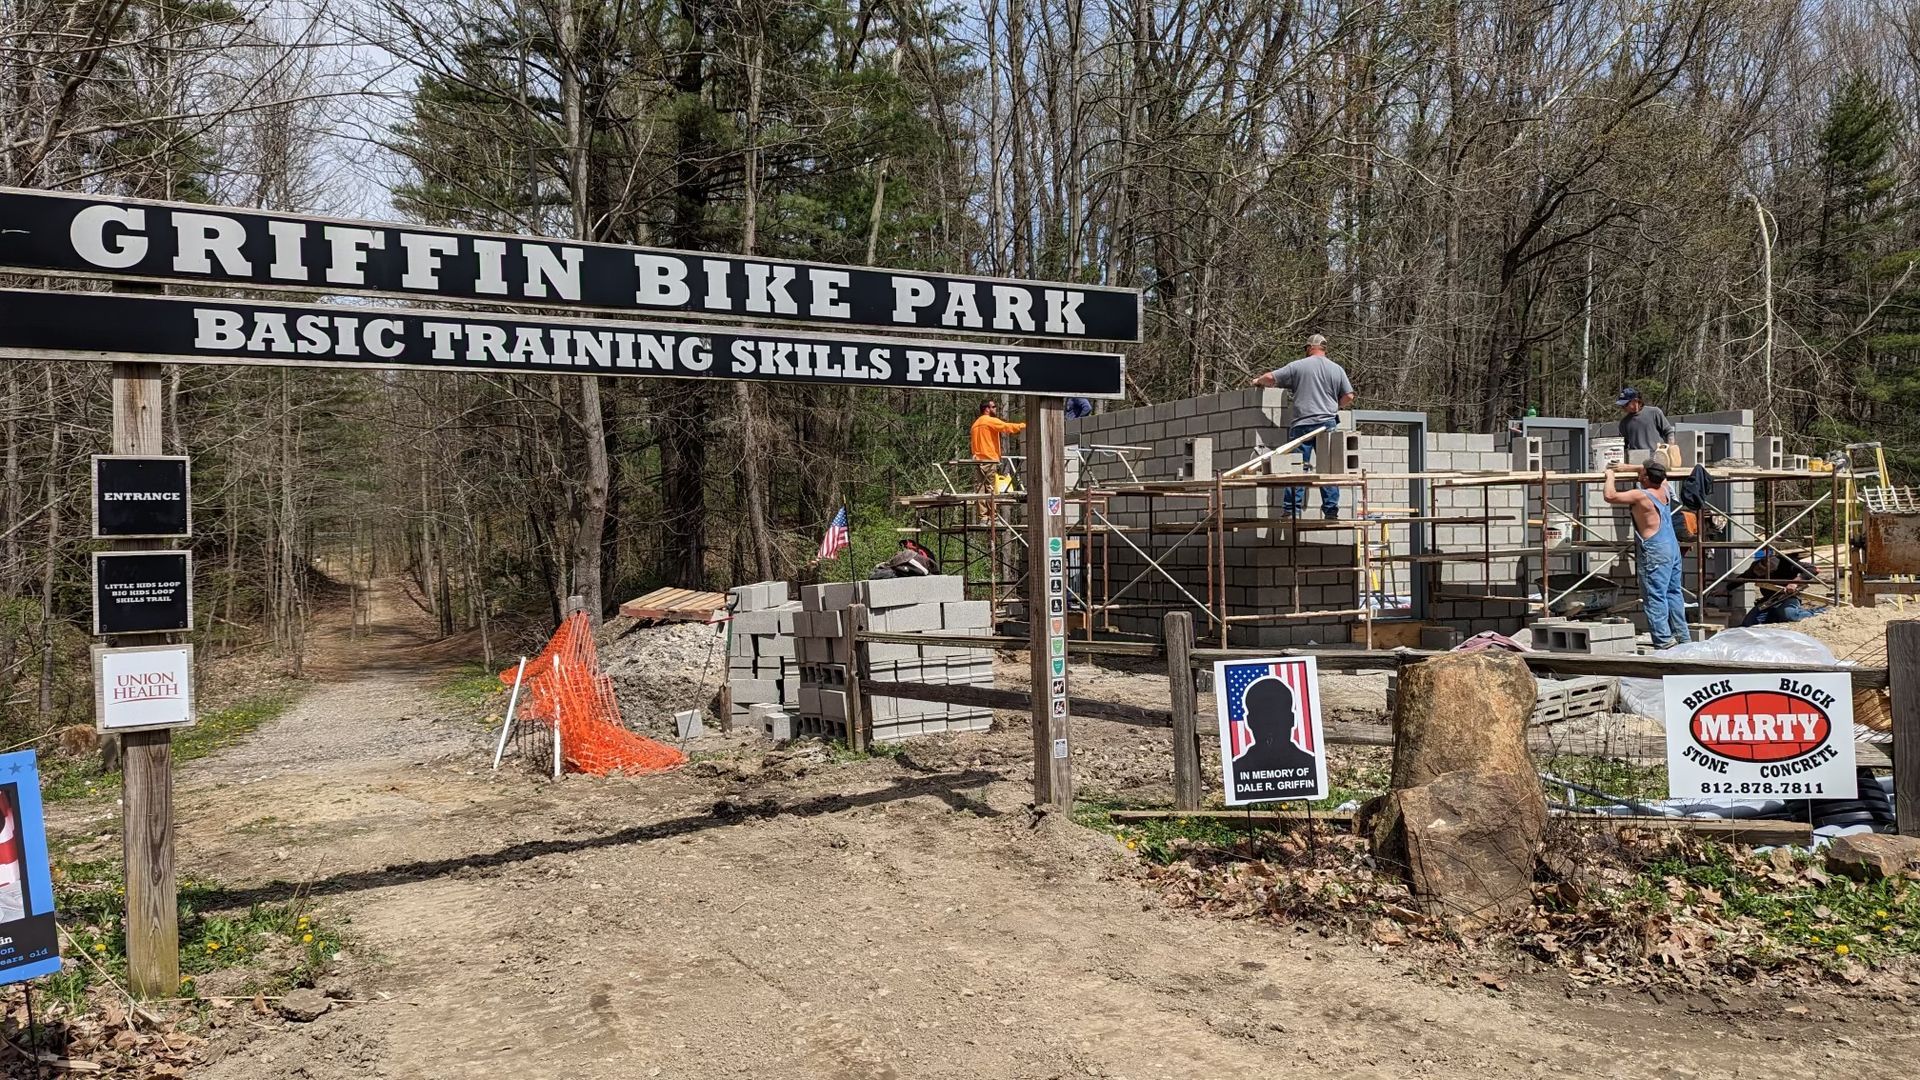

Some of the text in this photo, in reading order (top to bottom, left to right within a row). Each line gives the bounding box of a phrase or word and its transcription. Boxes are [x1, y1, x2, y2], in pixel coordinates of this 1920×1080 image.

[70, 204, 1086, 335] GRIFFIN BIKE PARK
[193, 308, 1022, 386] BASIC TRAINING SKILLS PARK
[104, 492, 180, 501] ENTRANCE
[117, 671, 175, 687] UNION
[113, 683, 179, 700] HEALTH
[1682, 677, 1836, 711] BRICK BLOCK
[1700, 713, 1819, 741] MARTY
[1682, 744, 1839, 779] STONE CONCRETE
[1240, 767, 1310, 780] IN MEMORY OF
[1236, 779, 1315, 793] DALE R. GRIFFIN
[1701, 782, 1824, 794] 812.878.7811
[0, 948, 48, 966] ears old
